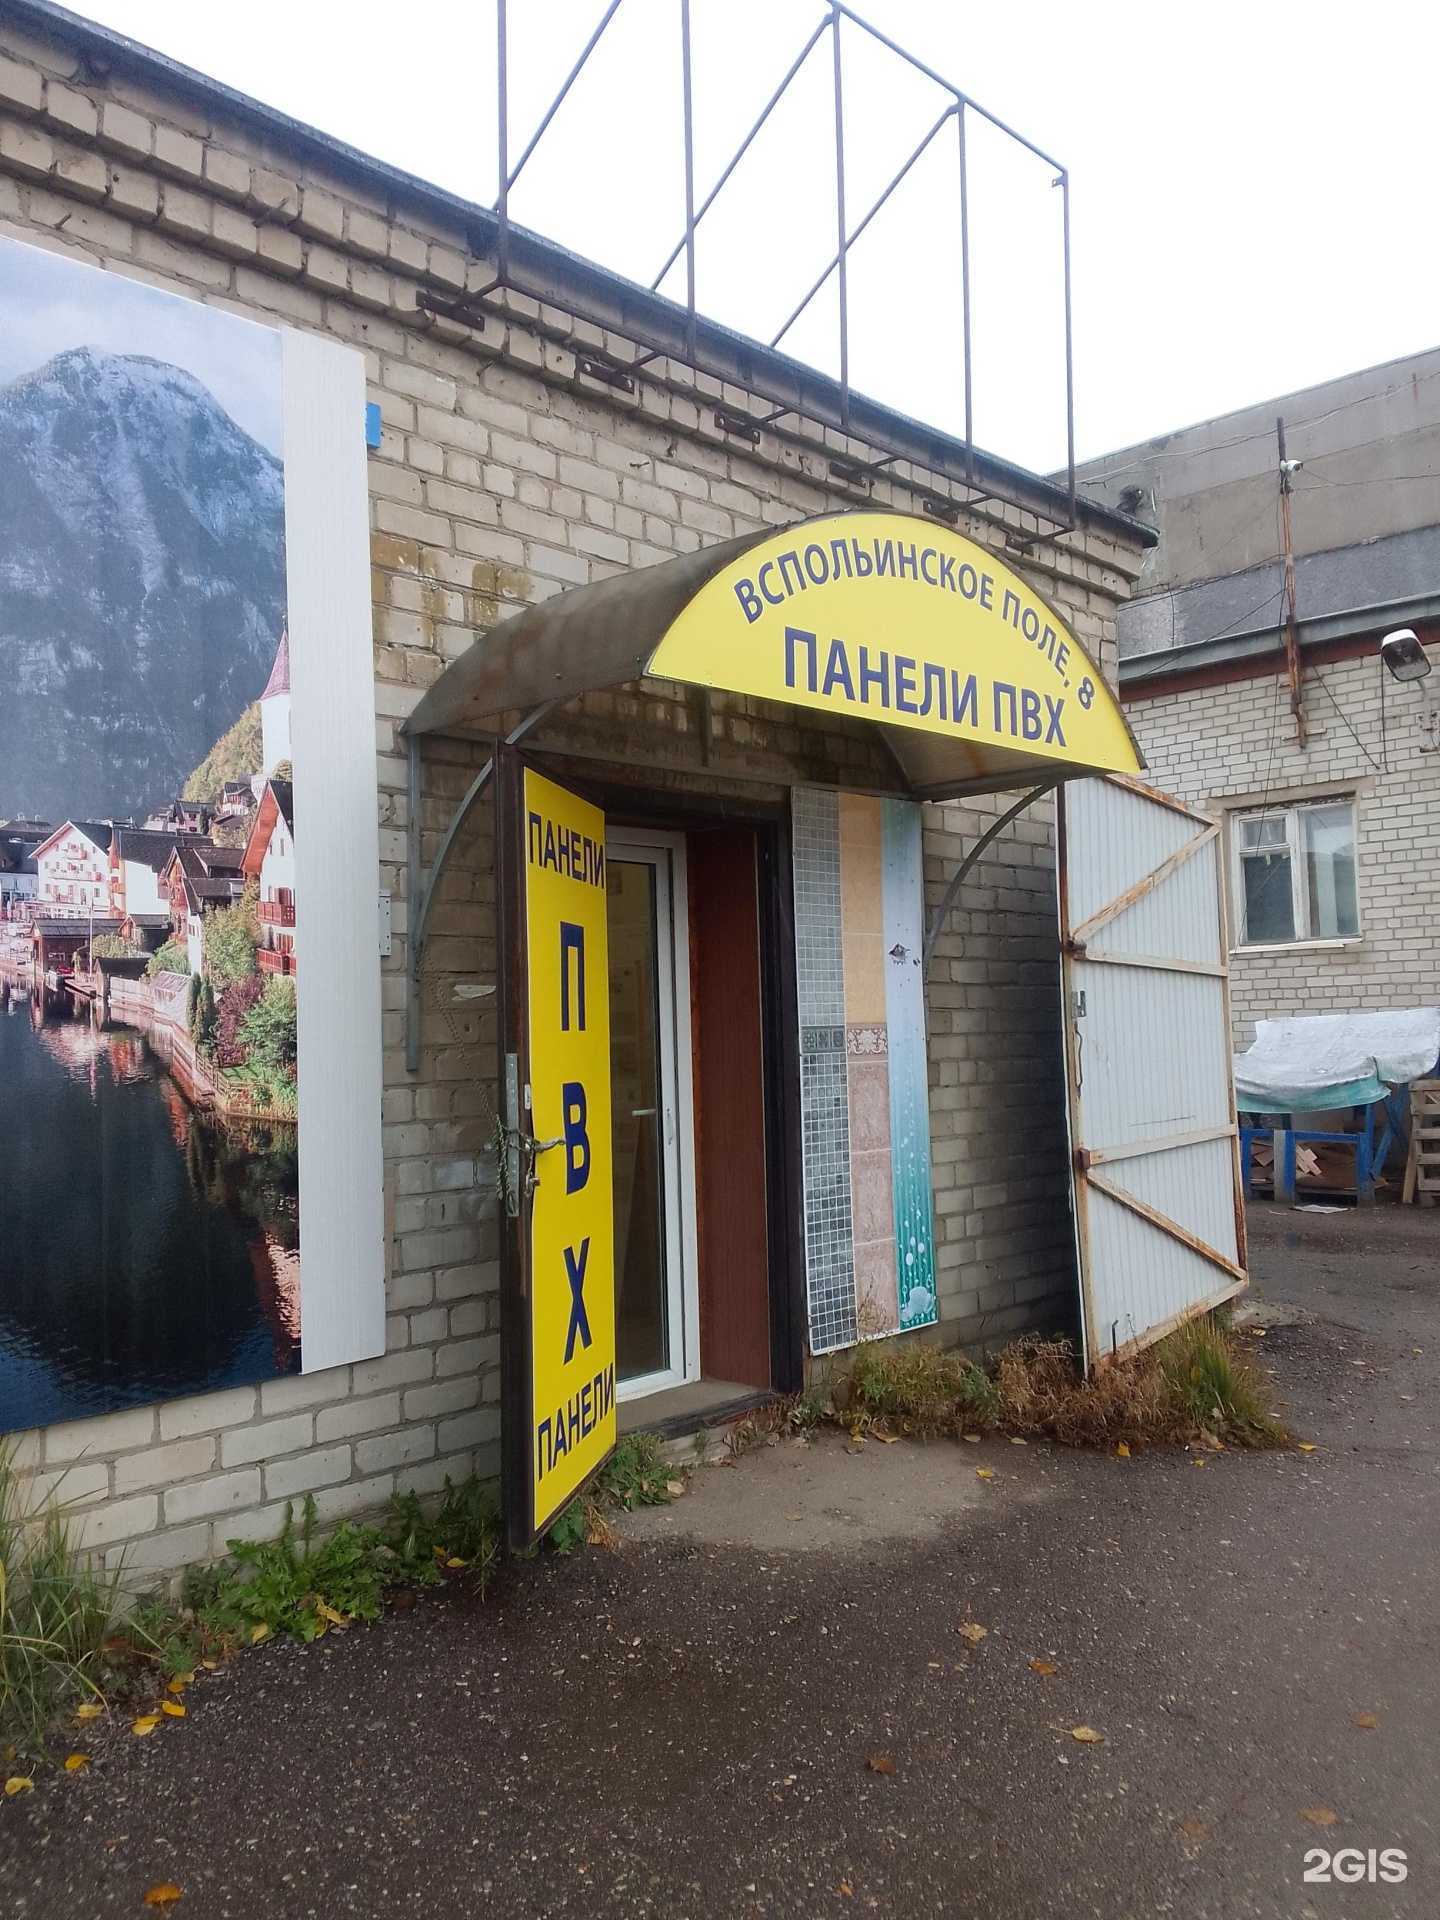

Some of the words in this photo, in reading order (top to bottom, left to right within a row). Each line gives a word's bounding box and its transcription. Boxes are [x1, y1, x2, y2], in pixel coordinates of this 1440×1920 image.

[734, 538, 994, 624] ВСПОЛЬИНСКОЕ
[1078, 676, 1095, 710] 8
[784, 627, 979, 728] ПАНЕЛИ
[993, 681, 1067, 747] ПВХ
[529, 811, 605, 888] ПАНЕЛИ
[537, 1362, 615, 1481] ПАНЕЛИ
